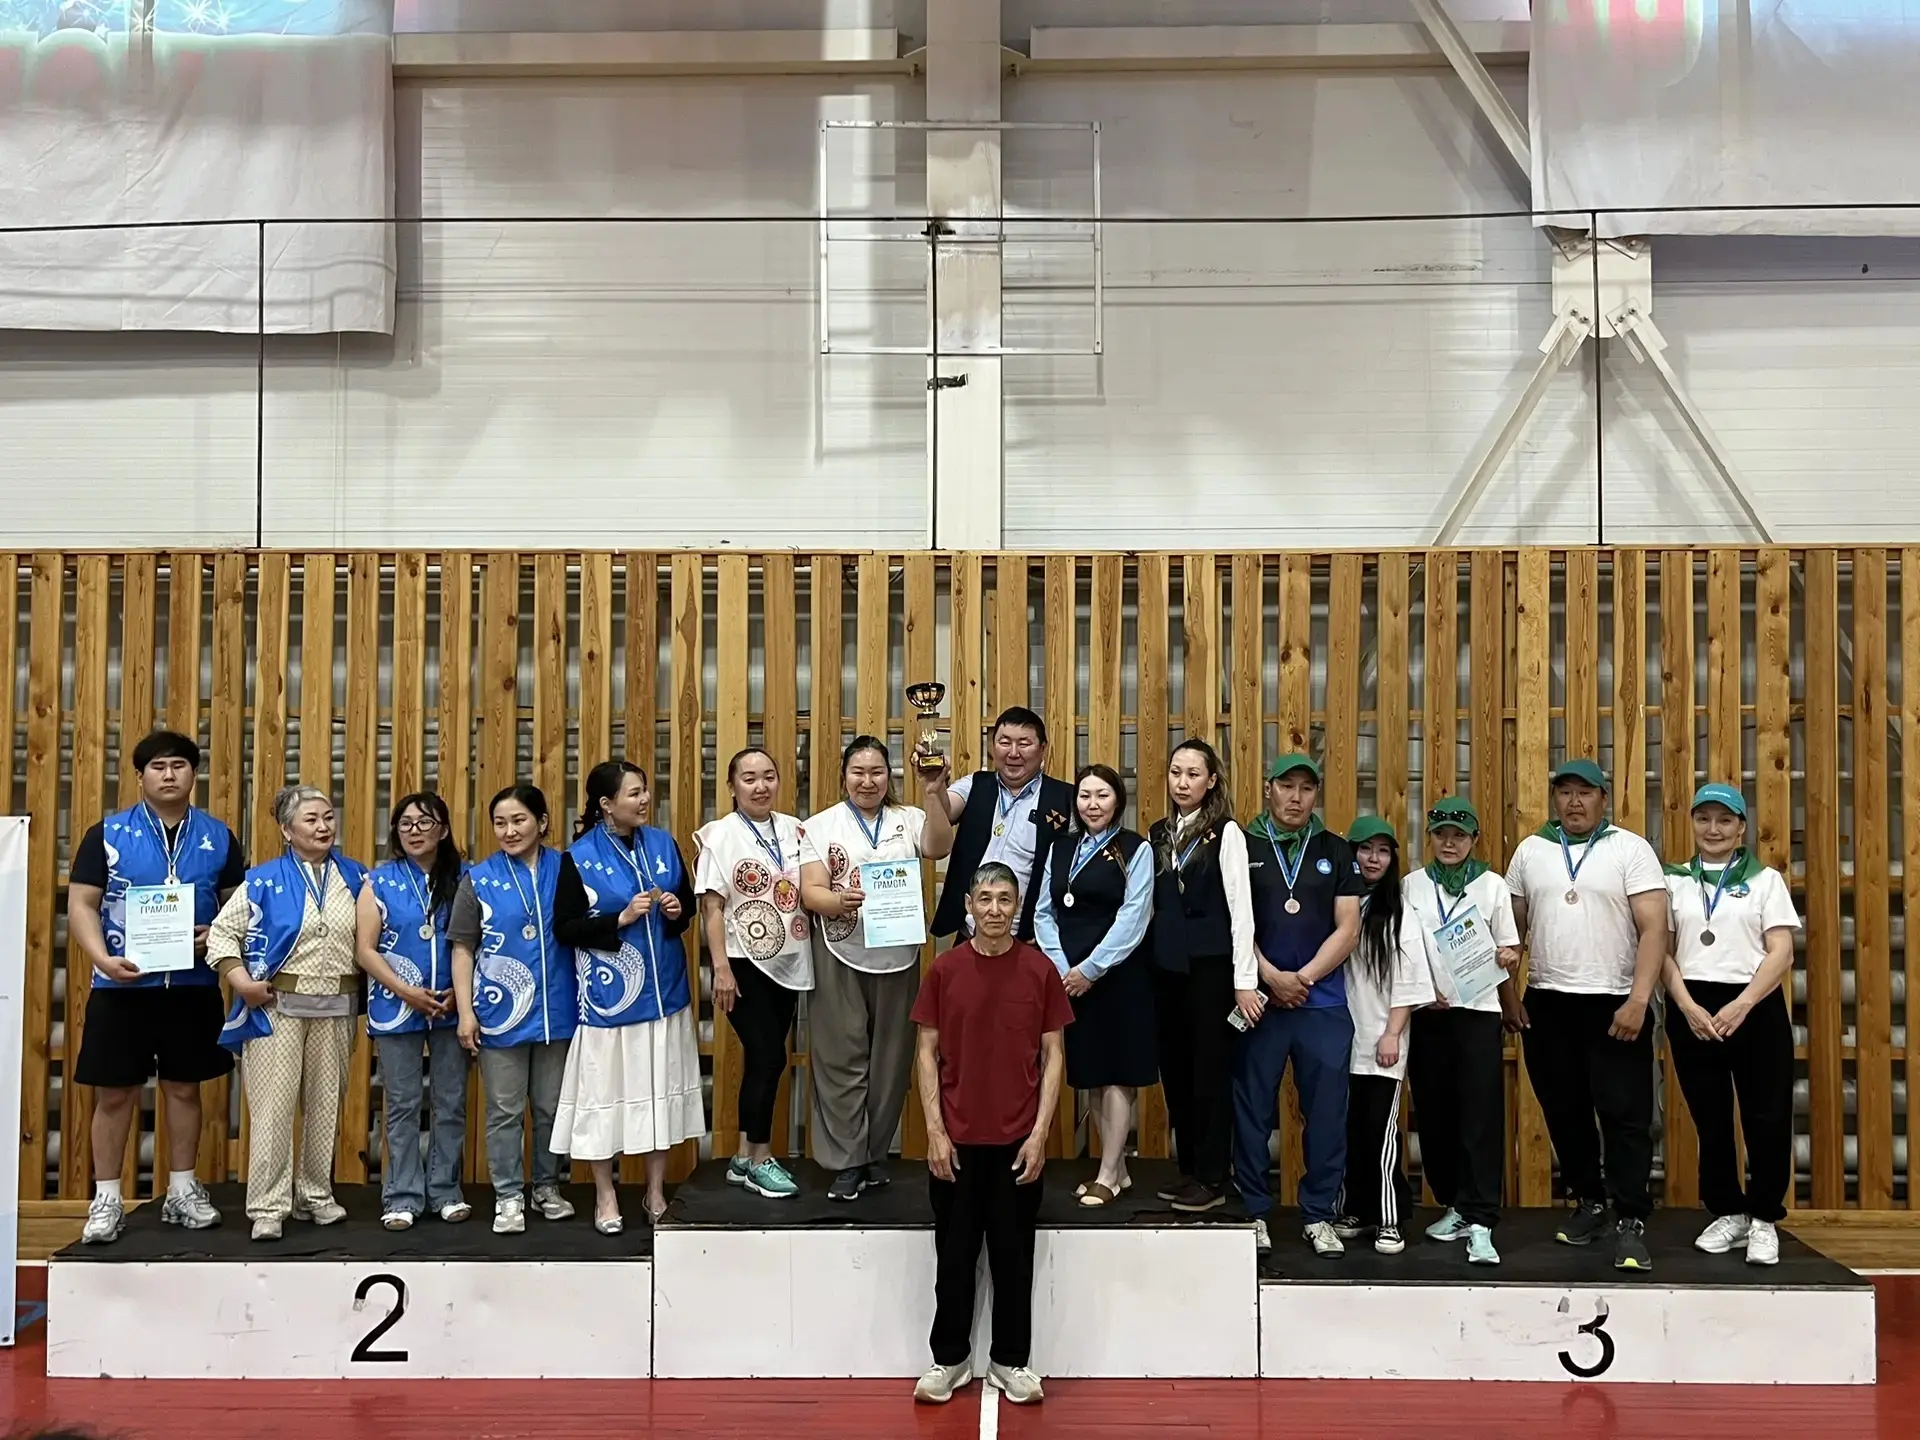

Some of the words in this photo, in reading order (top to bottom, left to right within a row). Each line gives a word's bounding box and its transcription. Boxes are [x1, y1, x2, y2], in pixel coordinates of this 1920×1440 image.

[873, 879, 907, 889] ГРАМОТА
[140, 904, 178, 914] ГРАМОТА
[1450, 928, 1477, 949] ГРАМОТА
[350, 1273, 409, 1362] 2
[1557, 1296, 1615, 1378] 3
